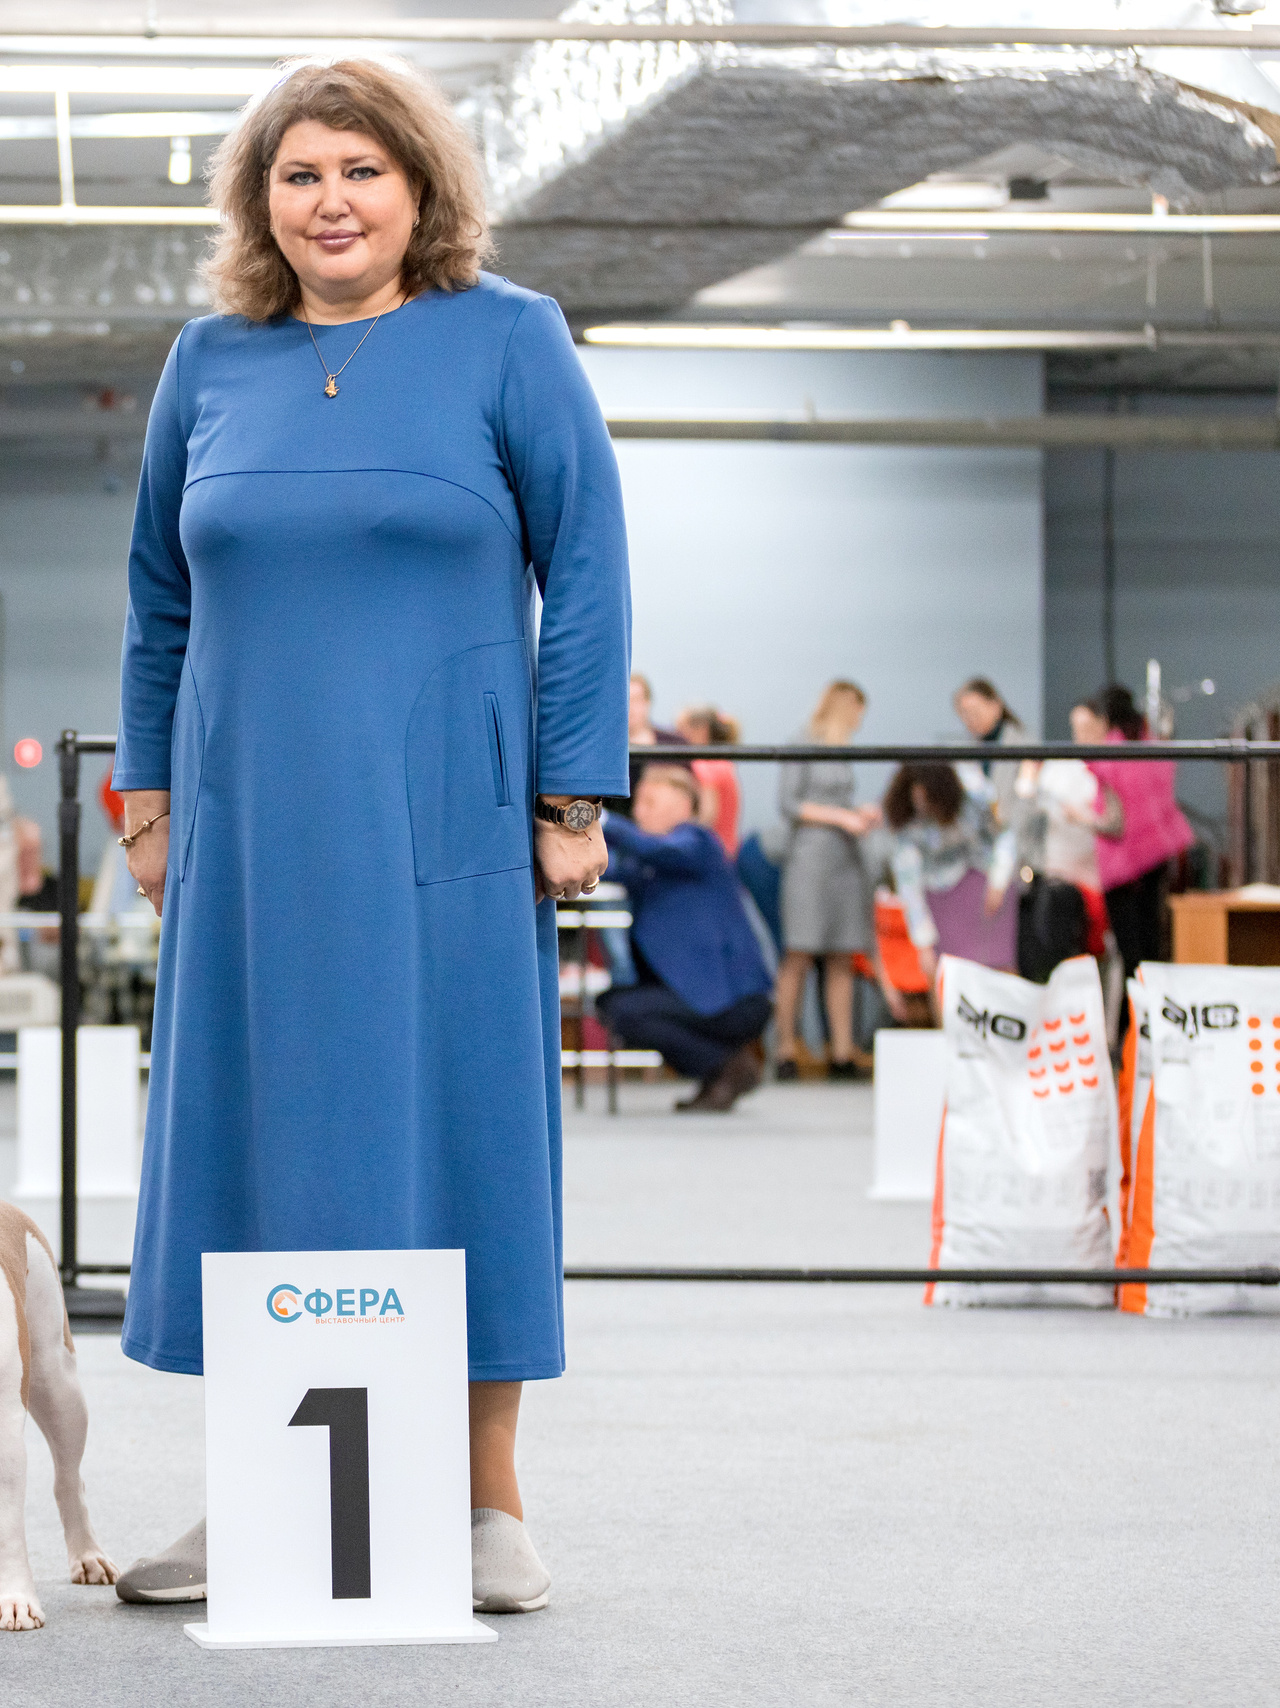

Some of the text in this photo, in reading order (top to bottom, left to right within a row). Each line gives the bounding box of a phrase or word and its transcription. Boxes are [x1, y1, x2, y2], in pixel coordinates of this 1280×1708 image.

[266, 1283, 405, 1323] СФЕРА
[315, 1316, 406, 1324] ВЫСТАВОЧНЫЙ ЦЕНТР
[287, 1387, 371, 1600] 1
